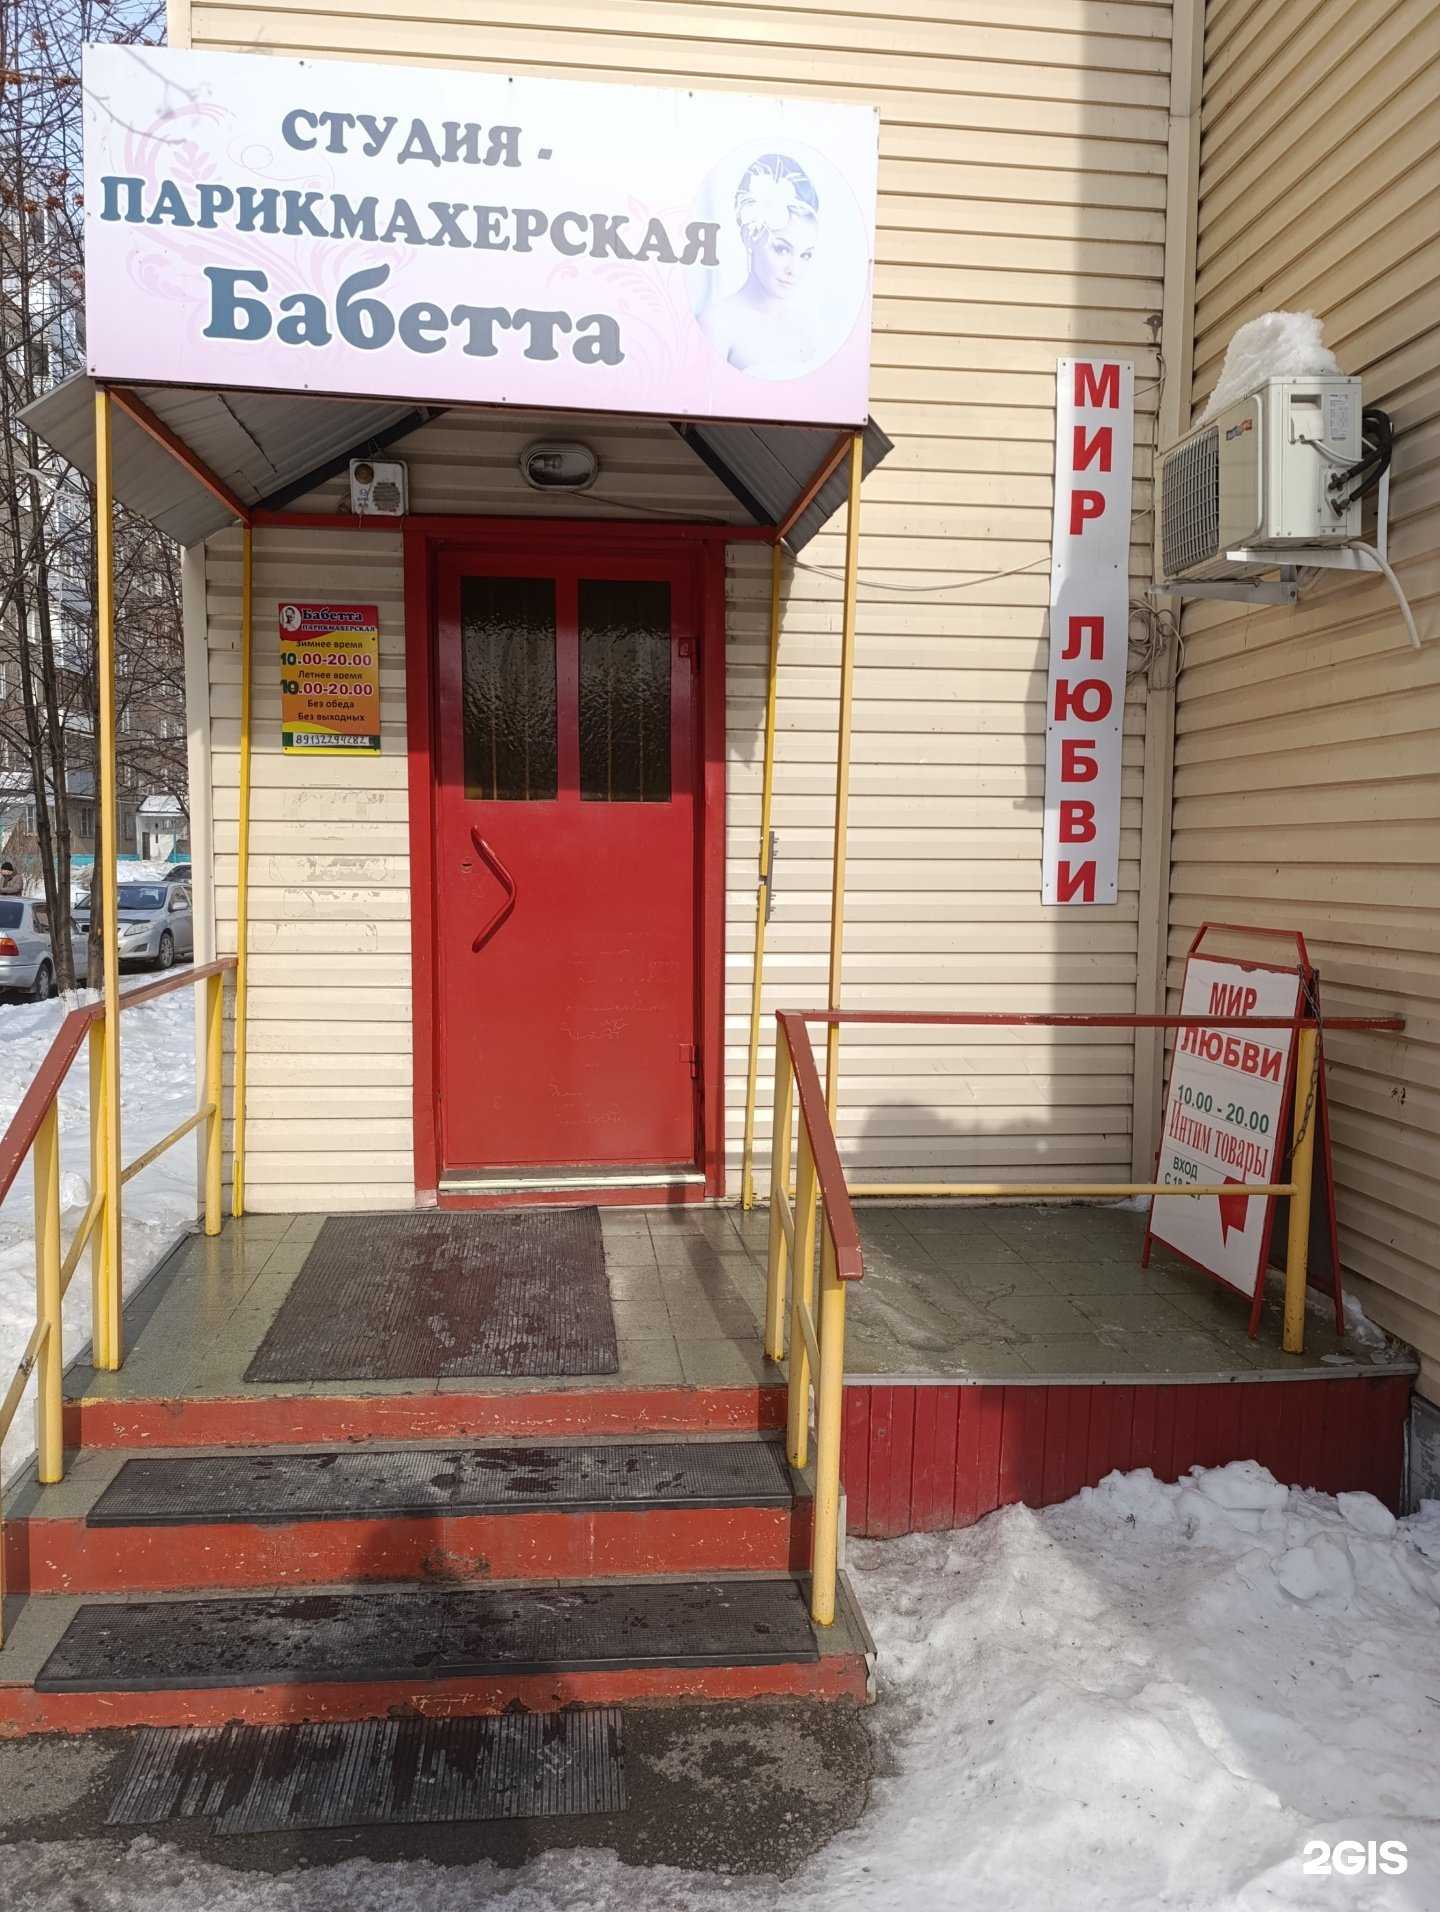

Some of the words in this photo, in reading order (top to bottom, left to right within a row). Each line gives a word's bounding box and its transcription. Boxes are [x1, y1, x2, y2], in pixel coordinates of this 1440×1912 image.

[281, 108, 524, 168] СТУДИЯ
[99, 176, 721, 267] ПАРИКМАХЕРСКАЯ
[203, 264, 625, 366] Бабетта
[1069, 362, 1120, 536] МИР
[303, 608, 363, 622] Бабетта
[333, 641, 363, 650] время
[298, 671, 330, 680] Летнее
[333, 673, 363, 681] время
[298, 712, 314, 721] Без
[317, 713, 365, 722] выходных
[308, 699, 323, 708] Без
[326, 700, 354, 709] обеда
[1054, 615, 1113, 903] ЛЮБВИ
[1209, 982, 1257, 1017] МИР
[1181, 1025, 1282, 1082] ЛЮБВИ
[1178, 1085, 1213, 1112] 10.00
[1226, 1103, 1269, 1133] 20.00
[1169, 1100, 1211, 1153] Интим
[1214, 1130, 1268, 1182] товары
[1173, 1156, 1197, 1181] ВХОД
